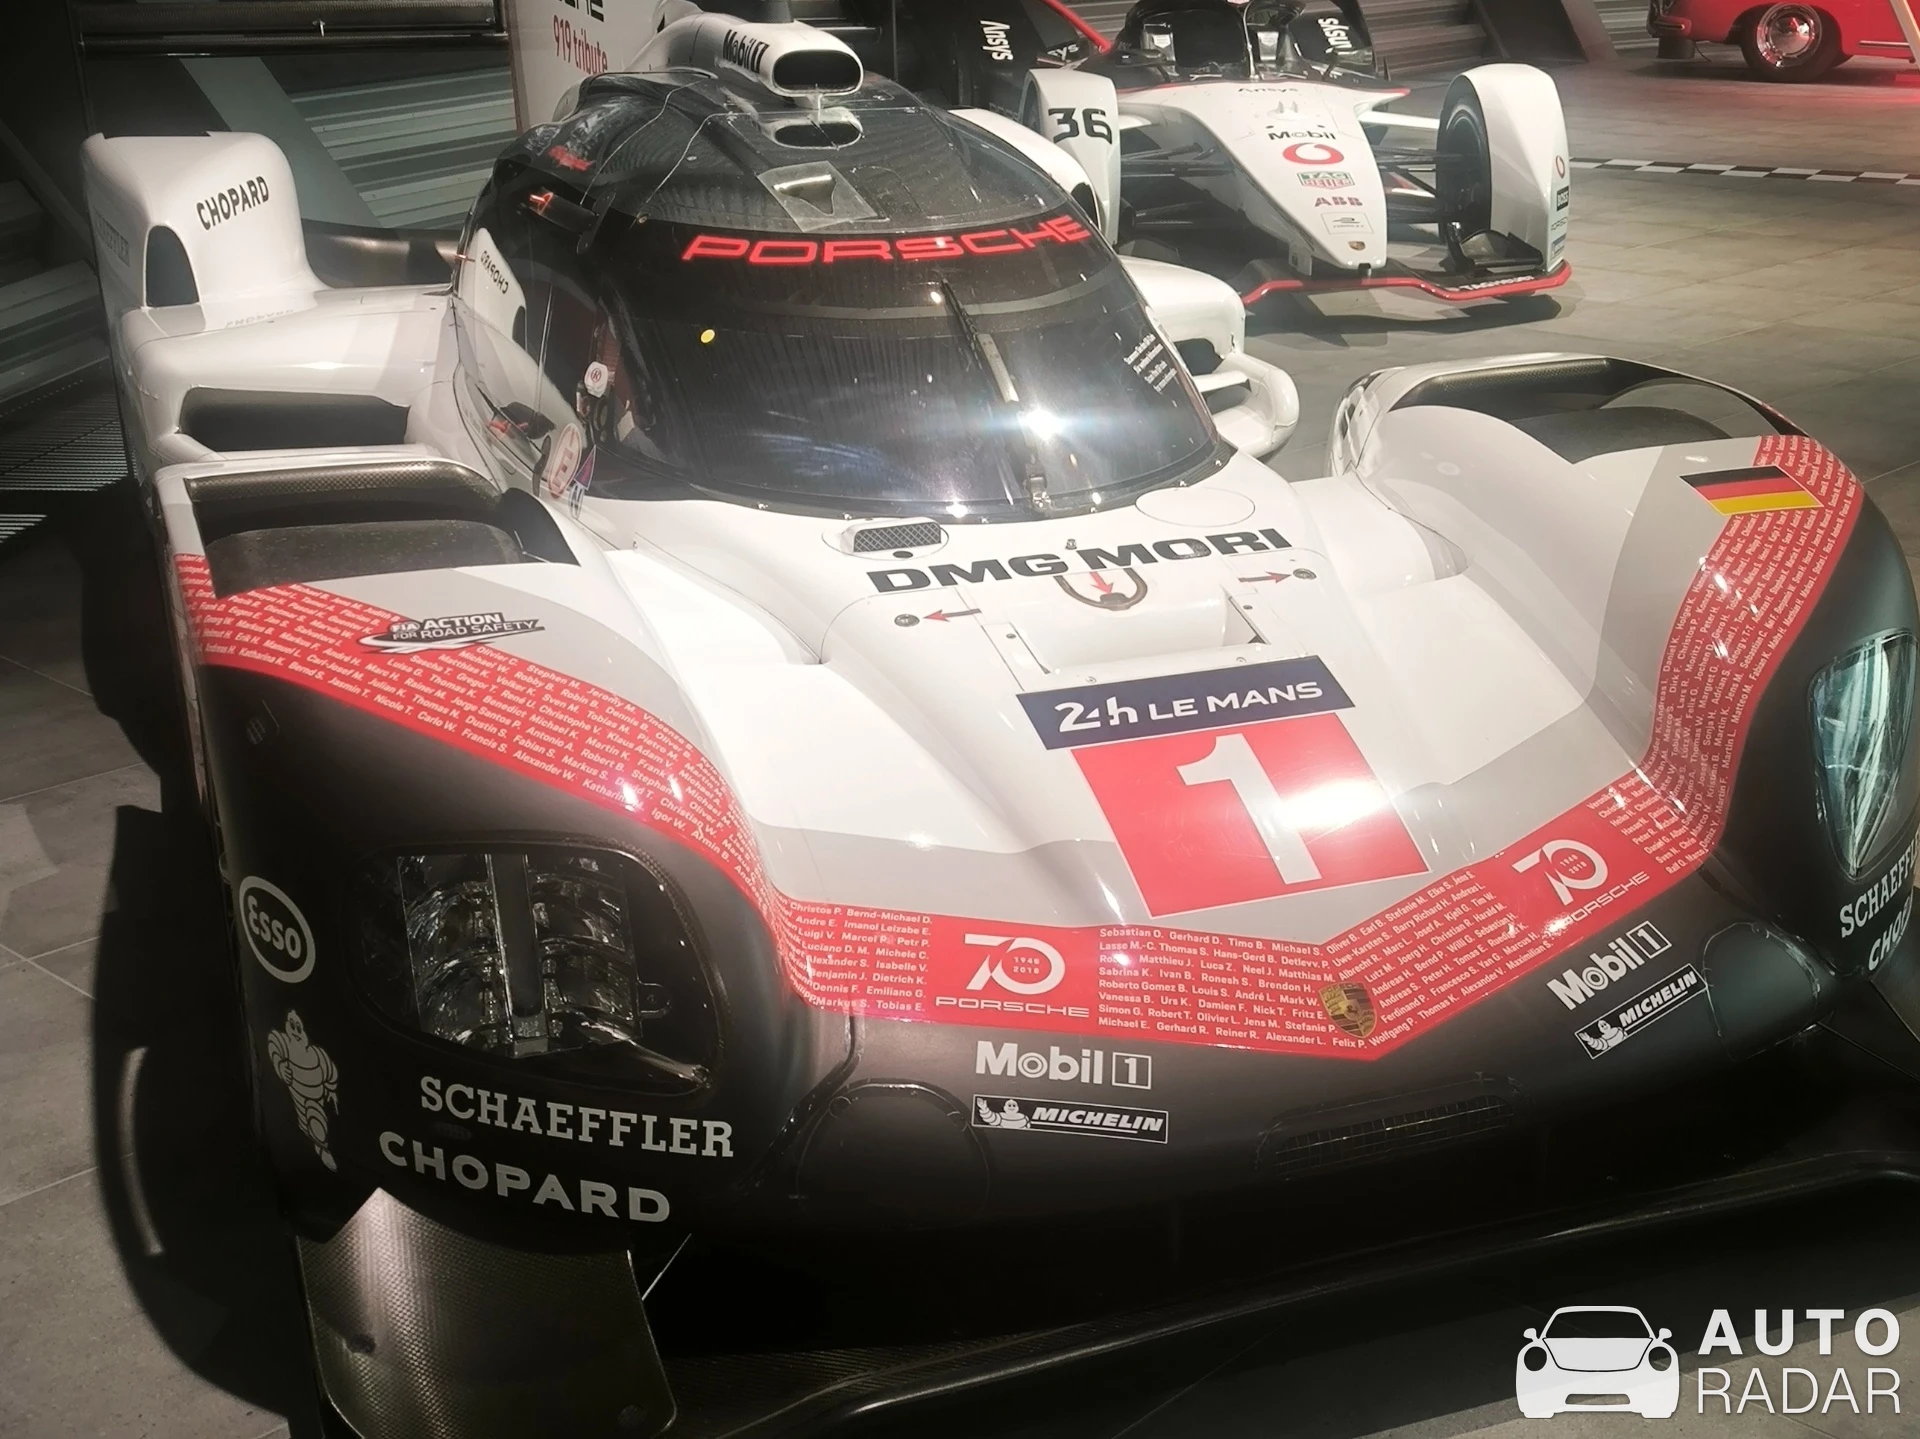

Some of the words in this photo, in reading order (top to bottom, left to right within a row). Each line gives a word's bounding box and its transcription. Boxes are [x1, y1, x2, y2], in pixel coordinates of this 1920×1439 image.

[553, 14, 571, 63] 919
[573, 28, 608, 75] tribute
[723, 29, 757, 70] Mobil
[980, 20, 1014, 61] Ansys
[1048, 107, 1112, 145] 36
[1267, 130, 1337, 140] Mobil
[196, 175, 270, 231] CHOPARD
[1314, 196, 1363, 207] ABB
[681, 214, 1091, 264] PORSCHE
[865, 554, 1069, 594] DMG
[1076, 528, 1293, 570] MORI
[391, 622, 418, 633] FIA
[393, 631, 417, 640] FOR
[420, 626, 467, 639] ROAD
[471, 620, 536, 634] SAFETY
[423, 613, 502, 630] ACTION
[287, 661, 315, 677] Bernd
[327, 676, 362, 695] Jasmin
[373, 693, 404, 712] Nicole
[417, 710, 444, 727] Carlo
[461, 727, 498, 749] Francis
[512, 749, 563, 776] Alexander
[1053, 695, 1139, 734] 24h
[1148, 698, 1199, 721] LE
[1206, 681, 1323, 713] MANS
[1721, 738, 1735, 769] Martin
[1730, 693, 1749, 724] Matteo
[1748, 657, 1768, 681] Fabian
[1176, 733, 1322, 885] 1
[789, 901, 832, 915] Christos
[833, 907, 842, 916] P.
[846, 908, 921, 923] Bernd-Michael
[922, 915, 932, 924] D.
[795, 915, 827, 927] Andre
[828, 918, 837, 928] E.
[921, 927, 931, 936] E.
[1325, 938, 1351, 955] Oliver
[1359, 922, 1379, 936] Earl
[1384, 901, 1418, 922] Stefanie
[1426, 886, 1446, 899] Elke
[801, 940, 843, 953] Luciano
[844, 944, 855, 954] D.
[856, 945, 870, 955] M.
[875, 947, 917, 959] Michele
[918, 950, 929, 960] C.
[1099, 927, 1151, 938] Sebastian
[1152, 929, 1164, 939] O.
[1169, 931, 1210, 944] Gerhard
[1211, 935, 1223, 945] D.
[1227, 937, 1254, 949] Timo
[1255, 940, 1266, 950] B.
[1271, 942, 1311, 955] Michael
[1312, 946, 1324, 957] S.
[964, 933, 1066, 995] 70
[1098, 964, 1140, 977] Sabrina
[1141, 967, 1153, 977] K.
[1159, 968, 1182, 979] Ivan
[1184, 970, 1195, 981] B.
[1241, 976, 1252, 987] S.
[1303, 983, 1315, 993] H.
[1546, 937, 1646, 1011] Mobil
[812, 981, 849, 994] Dennis
[850, 984, 860, 994] F.
[866, 985, 913, 998] Emiliano
[914, 988, 927, 998] G.
[935, 996, 1090, 1018] PORSCHE
[1098, 991, 1142, 1003] Vanessa
[1143, 994, 1154, 1004] B.
[1160, 995, 1179, 1006] Urs
[1180, 996, 1192, 1007] K.
[1198, 998, 1237, 1012] Damien
[1238, 1002, 1248, 1013] F.
[1253, 1004, 1276, 1016] Nick
[1276, 1006, 1287, 1017] T.
[1292, 1008, 1315, 1019] Fritz
[1316, 1010, 1327, 1020] E.
[1368, 1019, 1411, 1047] Wolfgang
[1417, 999, 1451, 1020] Thomas
[1460, 971, 1498, 997] Alexander
[1505, 947, 1546, 970] Maximilian
[1619, 970, 1698, 1028] MICHELIN
[1098, 1016, 1139, 1029] Michael
[1140, 1020, 1150, 1029] E.
[1156, 1021, 1198, 1034] Gerhard
[1198, 1025, 1209, 1035] R.
[1215, 1026, 1248, 1039] Reiner
[1249, 1029, 1260, 1040] R.
[1265, 1031, 1316, 1044] Alexander
[1316, 1035, 1327, 1046] L.
[1332, 1037, 1356, 1048] Felix
[1357, 1039, 1368, 1049] P.
[975, 1040, 1104, 1085] Mobil
[420, 1076, 734, 1157] SCHAEFFLER
[1031, 1107, 1164, 1132] MICHELIN
[378, 1131, 671, 1223] CHOPARD
